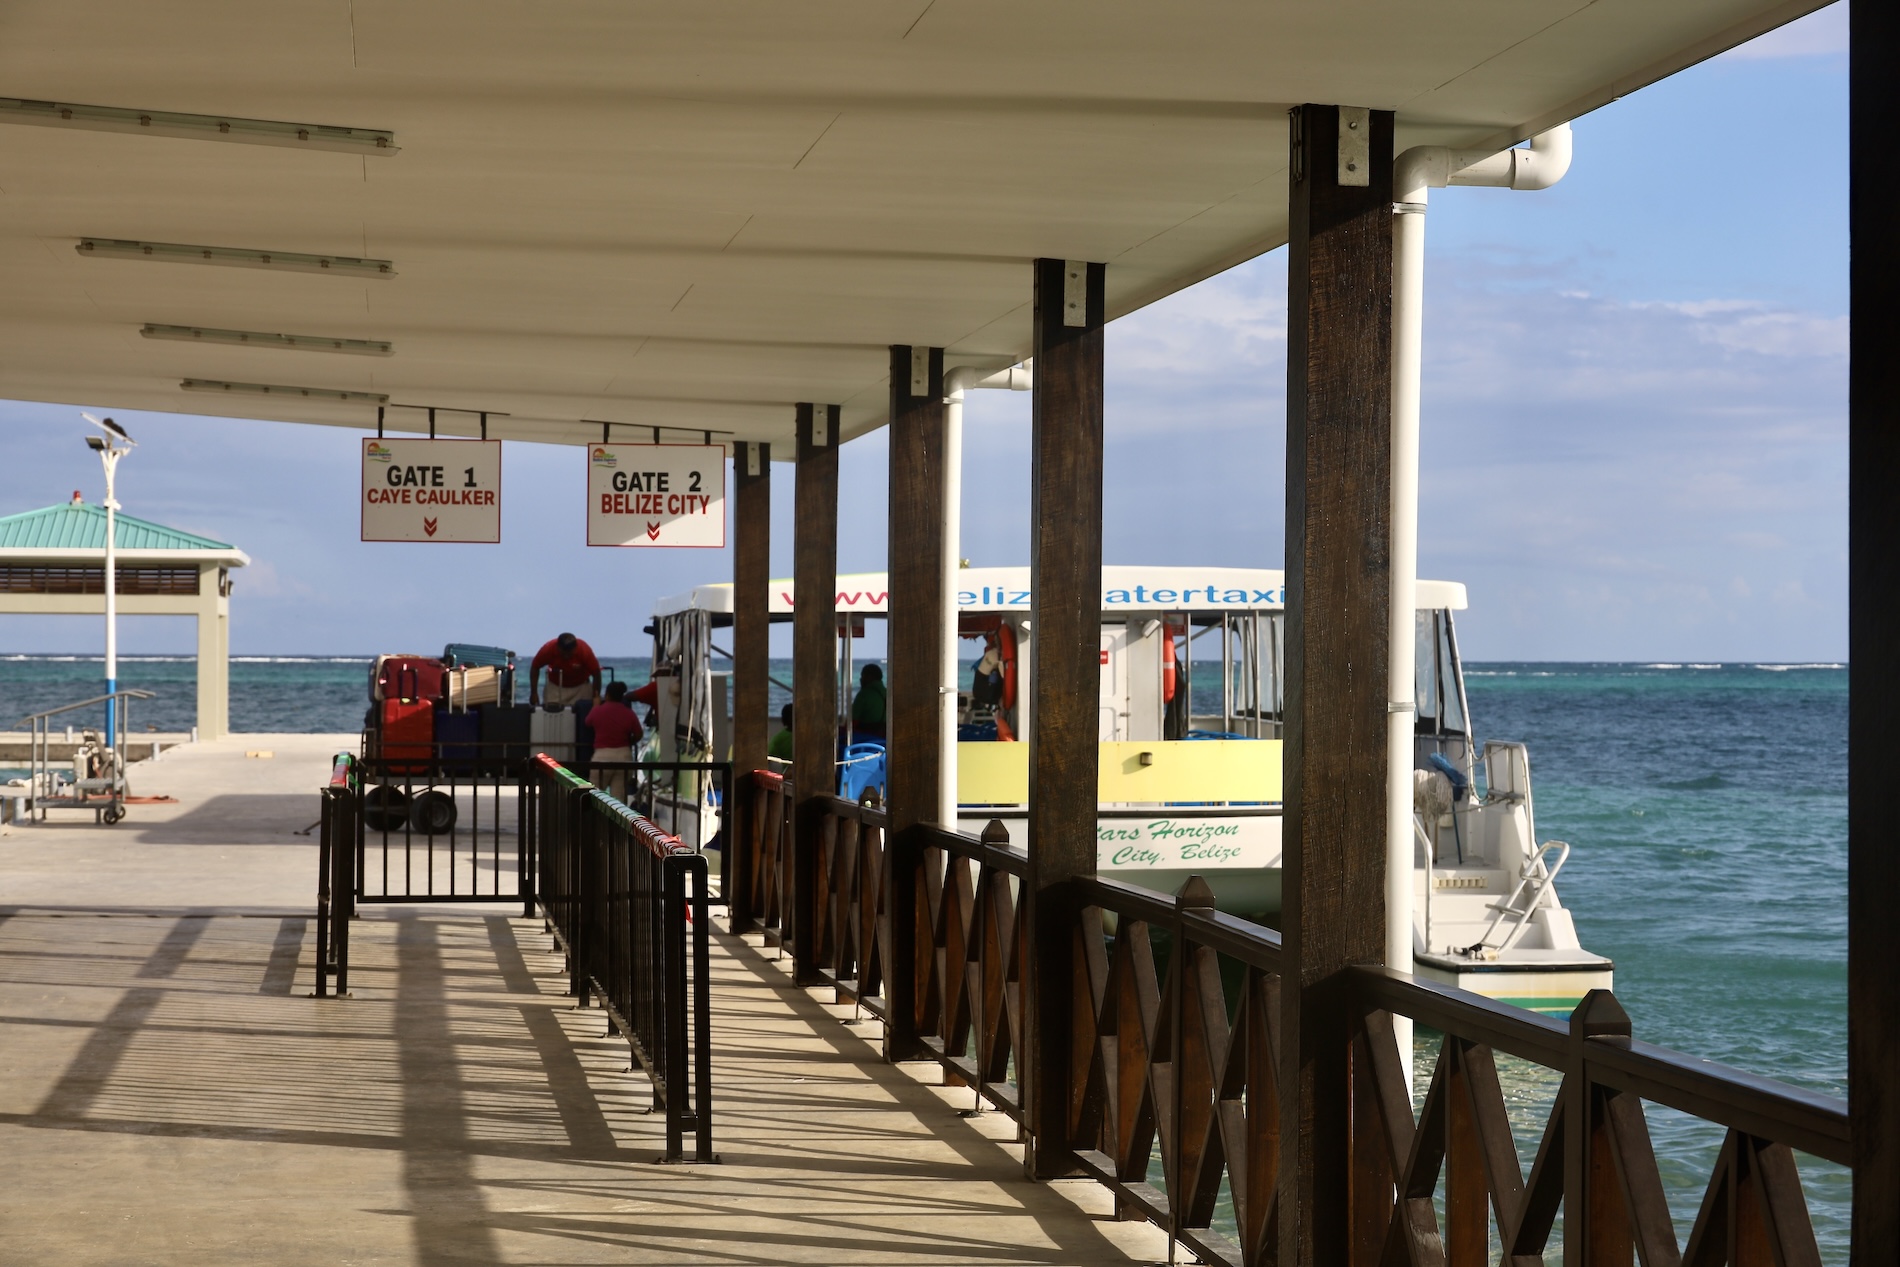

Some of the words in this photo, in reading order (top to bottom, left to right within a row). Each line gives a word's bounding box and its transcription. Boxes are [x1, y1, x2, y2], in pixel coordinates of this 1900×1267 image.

[387, 465, 444, 487] GATE
[464, 467, 477, 487] 1
[612, 471, 669, 492] GATE
[688, 471, 702, 492] 2
[367, 488, 412, 504] CAYE
[415, 489, 495, 505] CAULKER
[601, 493, 663, 514] BELIZE
[667, 494, 711, 515] CITY
[1147, 820, 1239, 844] Horizon
[1180, 843, 1241, 863] Belize
